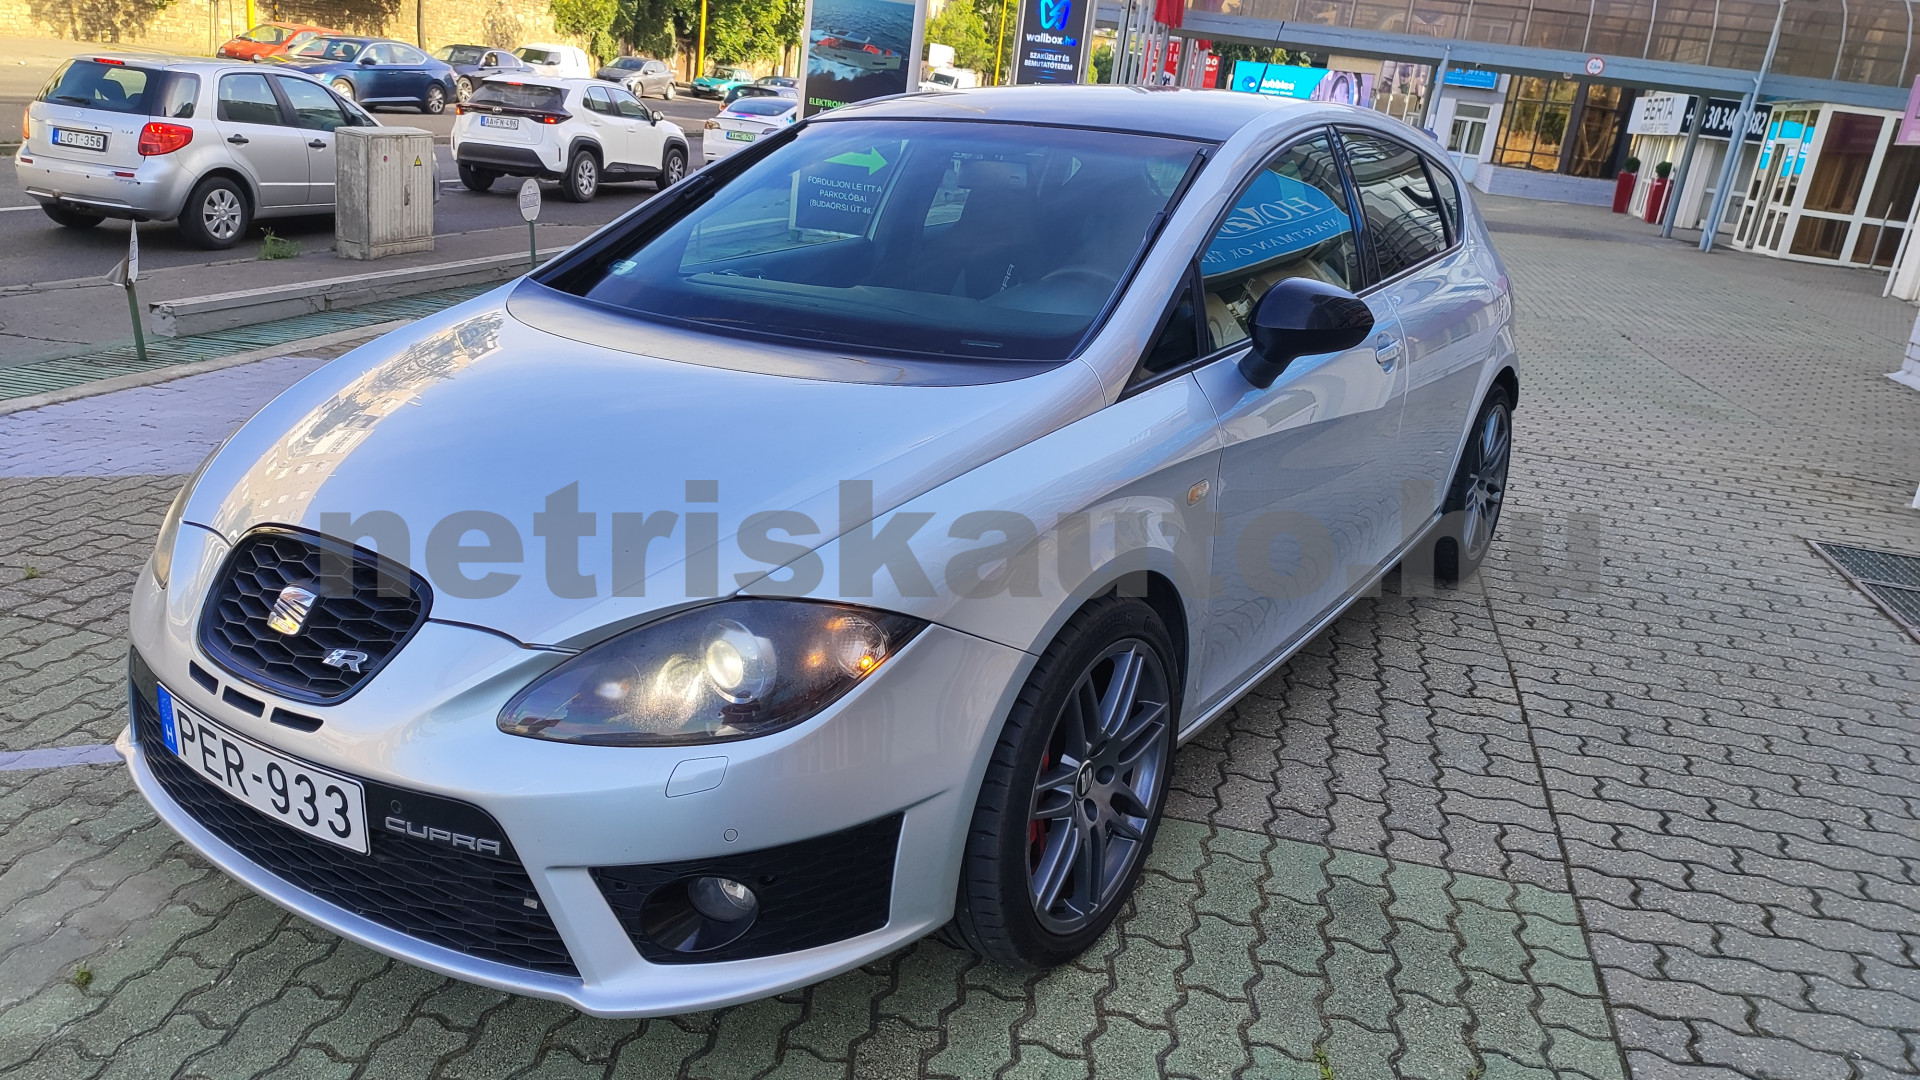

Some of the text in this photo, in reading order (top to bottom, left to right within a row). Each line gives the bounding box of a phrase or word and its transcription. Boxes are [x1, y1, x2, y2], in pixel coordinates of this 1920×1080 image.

[1026, 32, 1077, 46] wallbox.hu
[1024, 59, 1073, 71] BEMUTATÓTEREM
[1029, 52, 1062, 62] SZAKÜZLET
[1643, 97, 1676, 121] BERTA
[60, 132, 102, 148] LGT-356
[807, 175, 851, 189] FORDULJON
[852, 182, 862, 191] LE
[863, 184, 876, 193] ITT
[176, 707, 352, 840] PER-933
[384, 816, 501, 856] CUPRA
